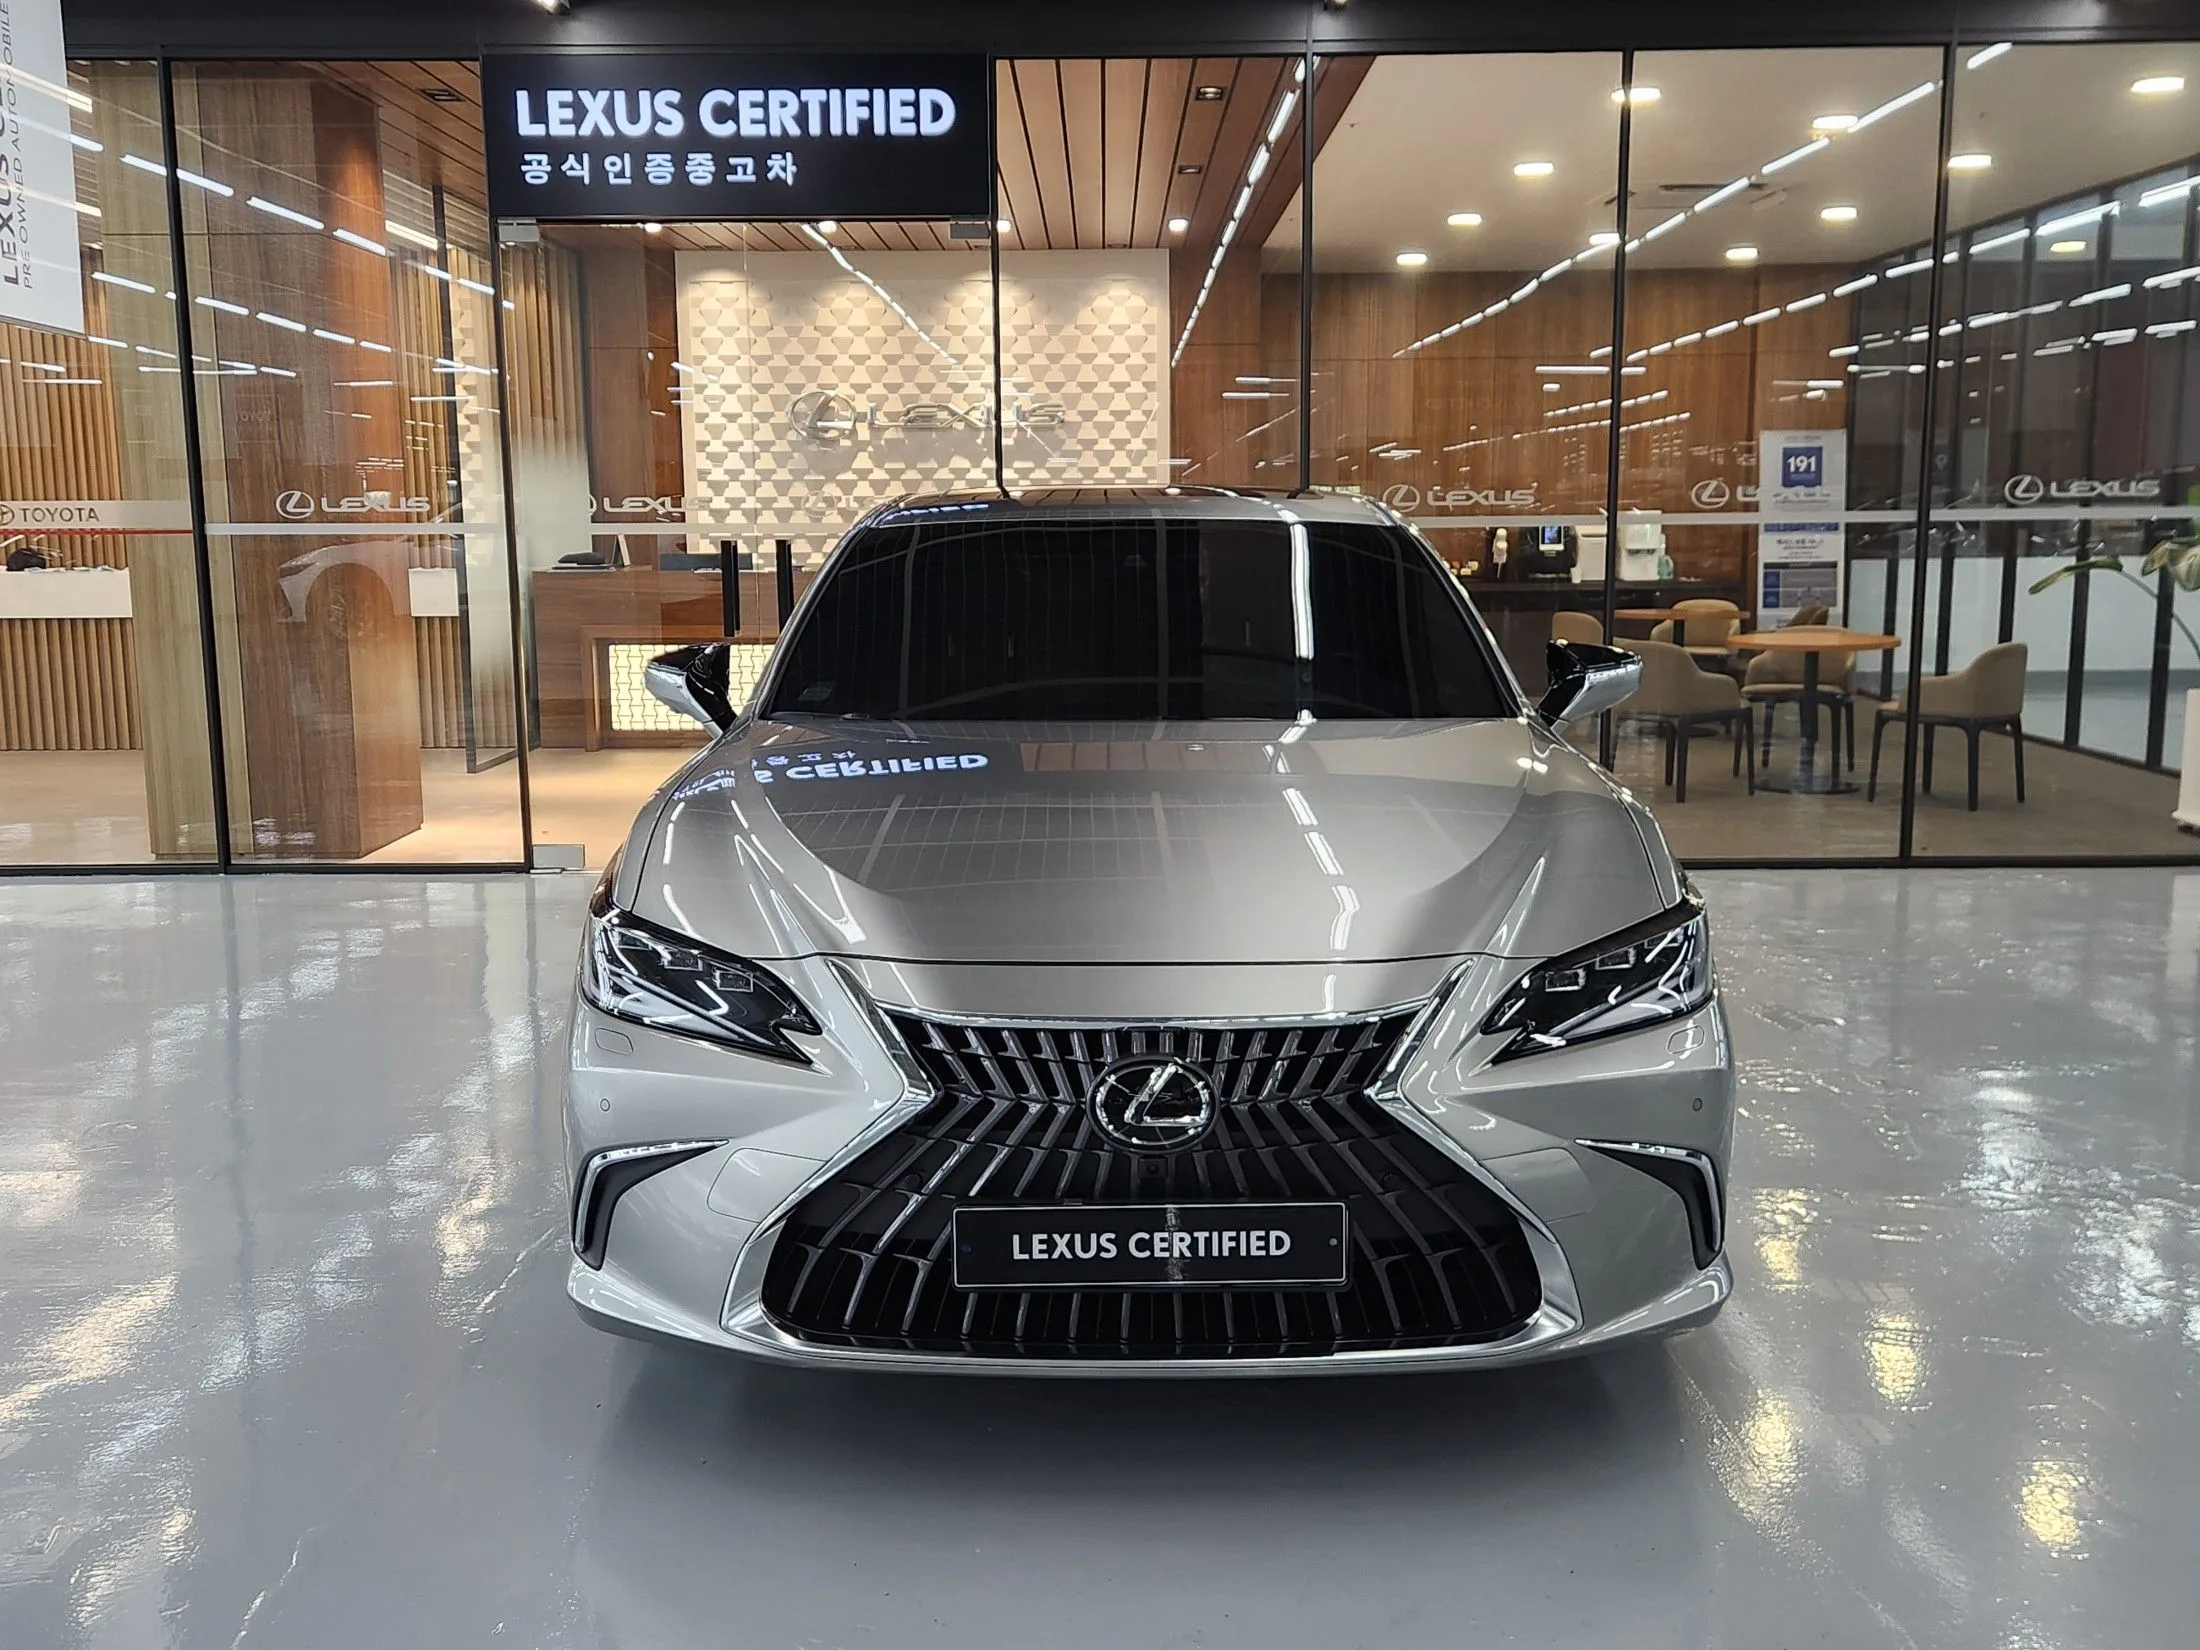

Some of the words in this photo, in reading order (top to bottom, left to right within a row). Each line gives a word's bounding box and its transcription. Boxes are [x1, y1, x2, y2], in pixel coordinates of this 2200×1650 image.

[516, 89, 684, 137] LEXUS
[699, 88, 956, 138] CERTIFIED
[520, 152, 798, 186] 공식인증중고차
[13, 157, 28, 244] OWNED
[23, 250, 33, 289] PRE
[866, 401, 1065, 428] LEXUS
[1787, 455, 1816, 473] 191
[1427, 489, 1536, 506] LEXUS
[2051, 479, 2161, 498] LEXUS
[20, 507, 101, 522] TOYOTA
[320, 496, 431, 513] LEXUS
[603, 496, 712, 513] LEXUS
[1012, 1232, 1117, 1260] LEXUS
[1128, 1230, 1291, 1259] CERTIFIED
